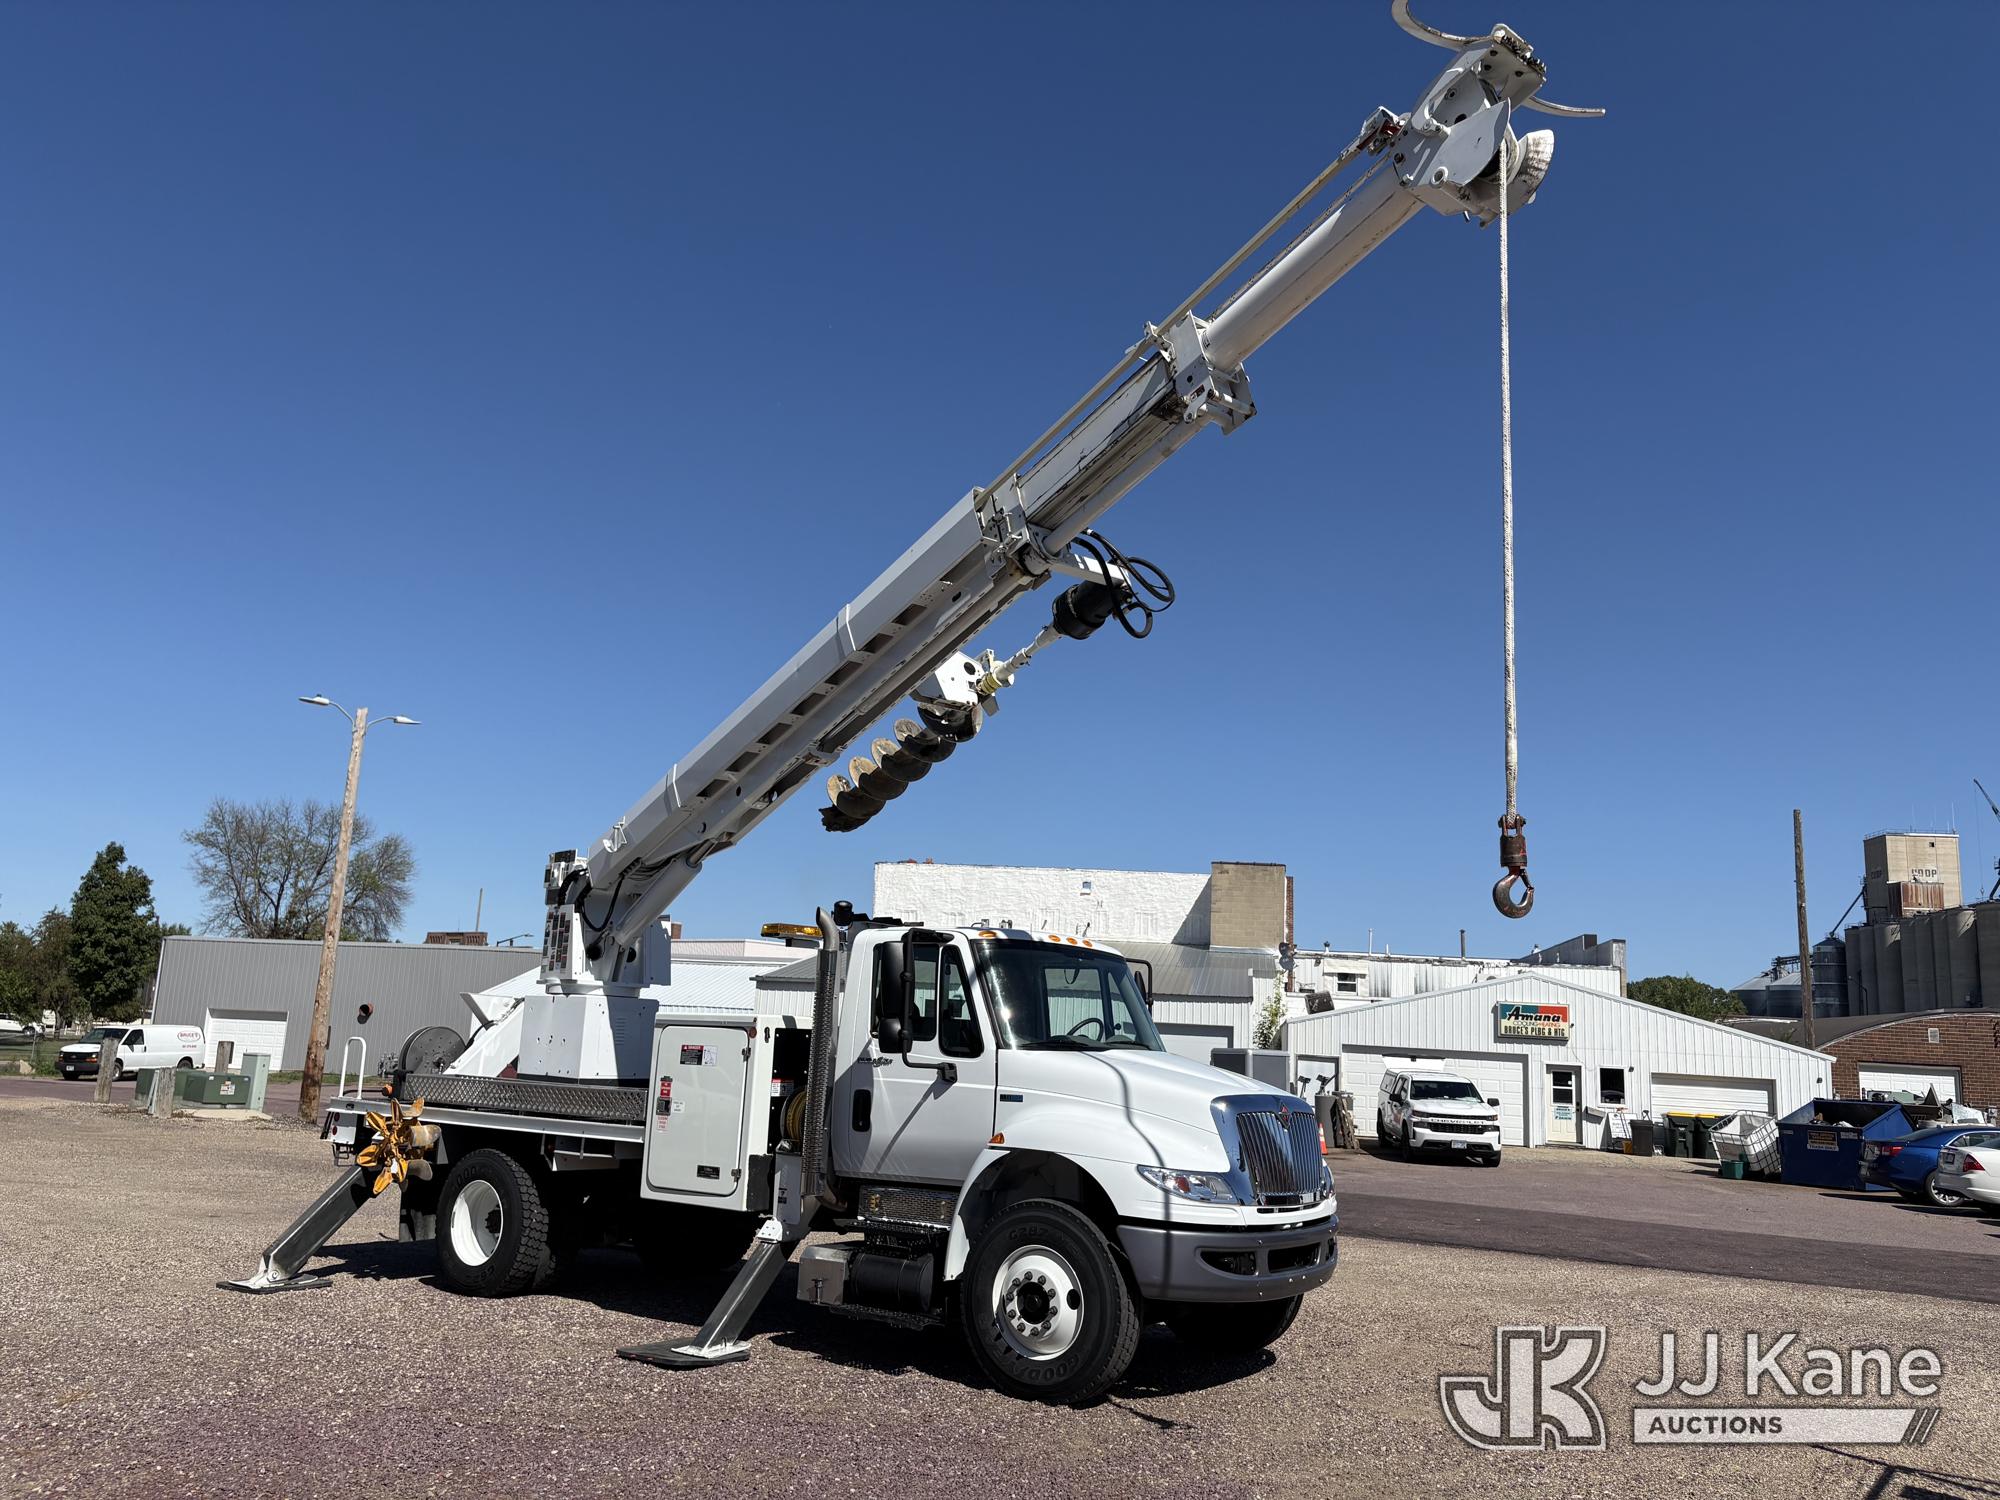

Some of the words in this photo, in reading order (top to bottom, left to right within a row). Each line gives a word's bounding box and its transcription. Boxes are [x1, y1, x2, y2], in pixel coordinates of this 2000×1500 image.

[1507, 1006, 1561, 1022] Amana
[1504, 1026, 1529, 1035] BRUCE'S
[1531, 1028, 1546, 1036] PLBG
[1554, 1029, 1565, 1037] HTG
